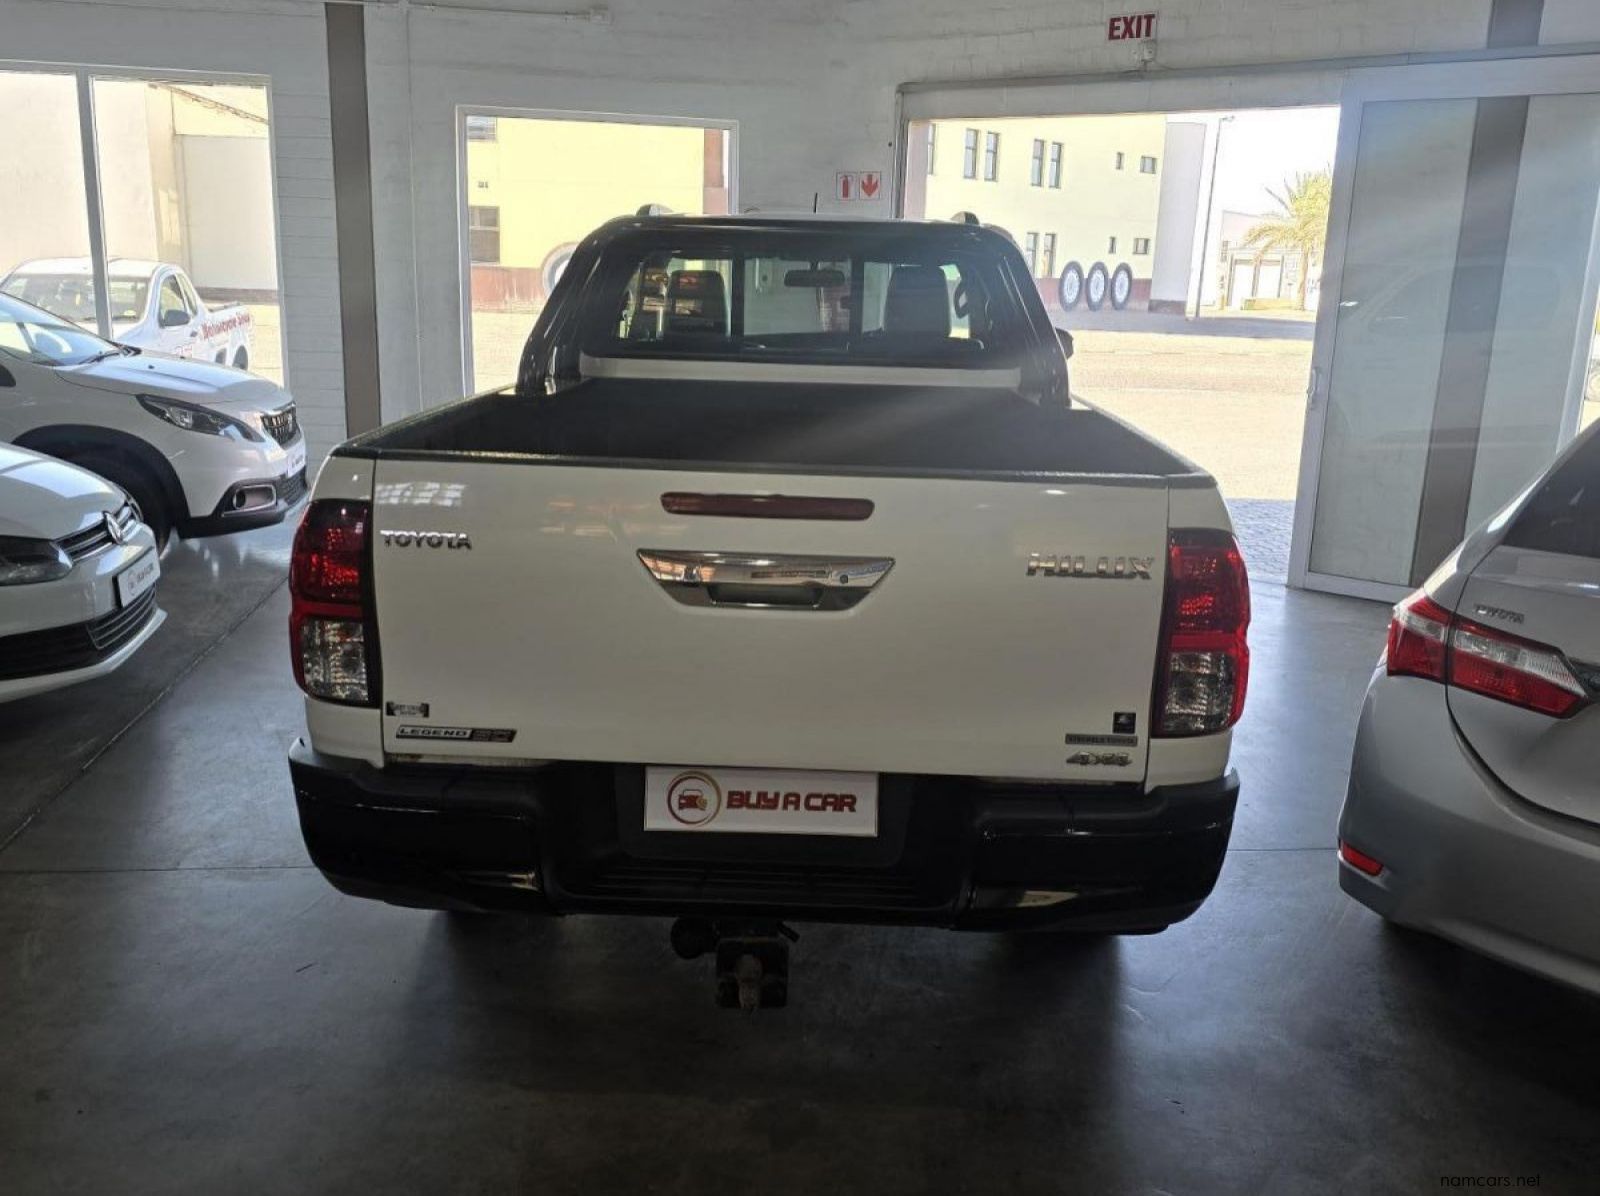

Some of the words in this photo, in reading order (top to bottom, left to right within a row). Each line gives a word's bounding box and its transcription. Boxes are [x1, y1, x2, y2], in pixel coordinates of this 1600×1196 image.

[1108, 13, 1155, 40] EXIT
[380, 529, 472, 550] TOYOTA
[1026, 553, 1154, 580] HILUX
[1473, 602, 1525, 625] TOYOTA
[400, 727, 468, 737] LEGEND
[726, 790, 780, 811] BUY
[782, 792, 800, 811] A
[804, 793, 857, 813] CAR
